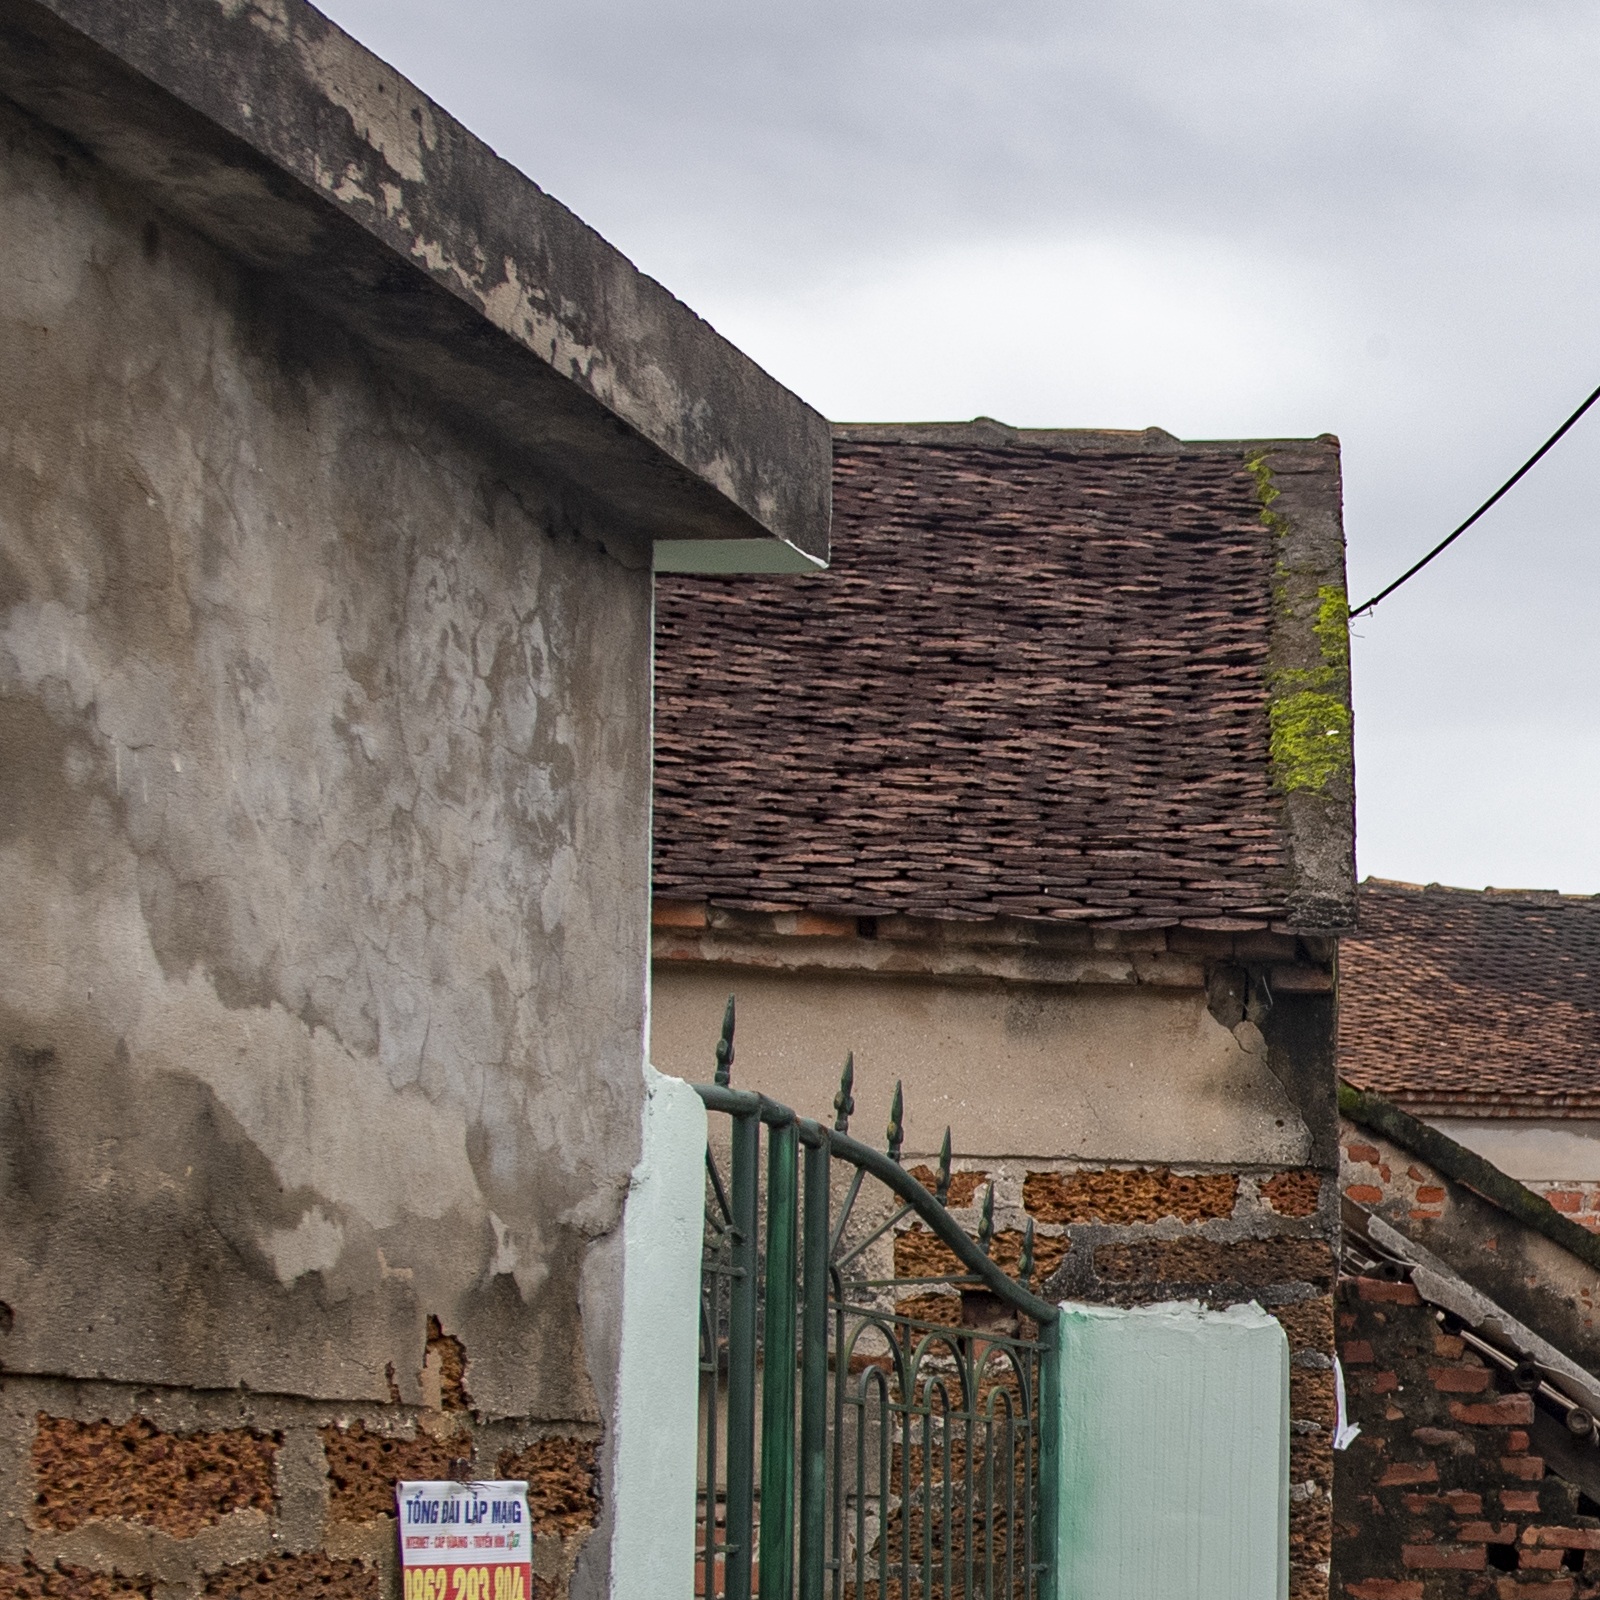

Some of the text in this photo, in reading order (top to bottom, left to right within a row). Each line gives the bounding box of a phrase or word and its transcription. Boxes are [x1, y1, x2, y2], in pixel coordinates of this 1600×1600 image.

[406, 1490, 439, 1524] TỔNG
[441, 1495, 460, 1524] ĐÀI
[491, 1500, 522, 1529] MẠNG
